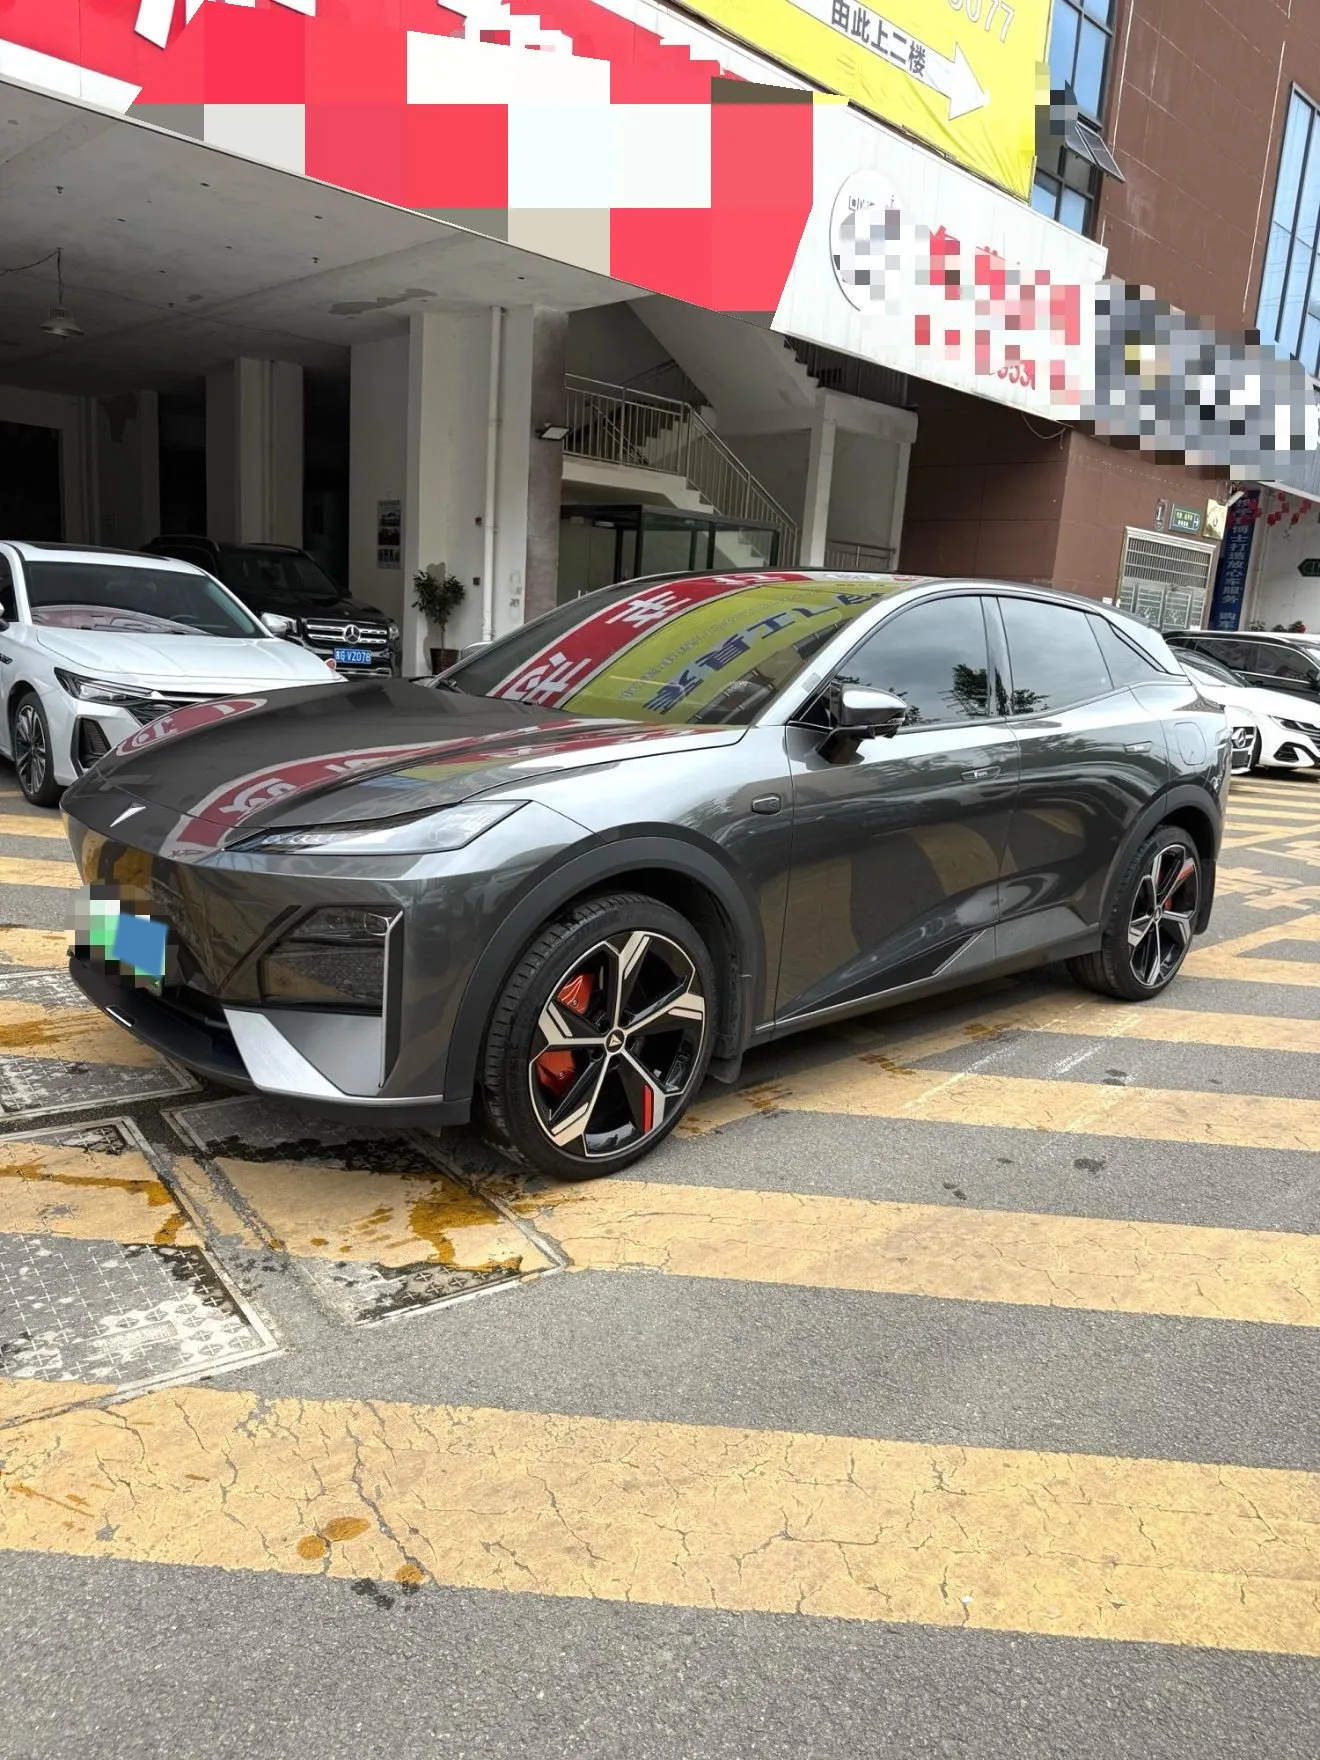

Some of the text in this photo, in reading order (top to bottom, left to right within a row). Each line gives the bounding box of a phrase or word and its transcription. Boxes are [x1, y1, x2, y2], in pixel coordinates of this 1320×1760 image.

[831, 0, 926, 77] 由此上二楼
[948, 0, 1015, 43] 077
